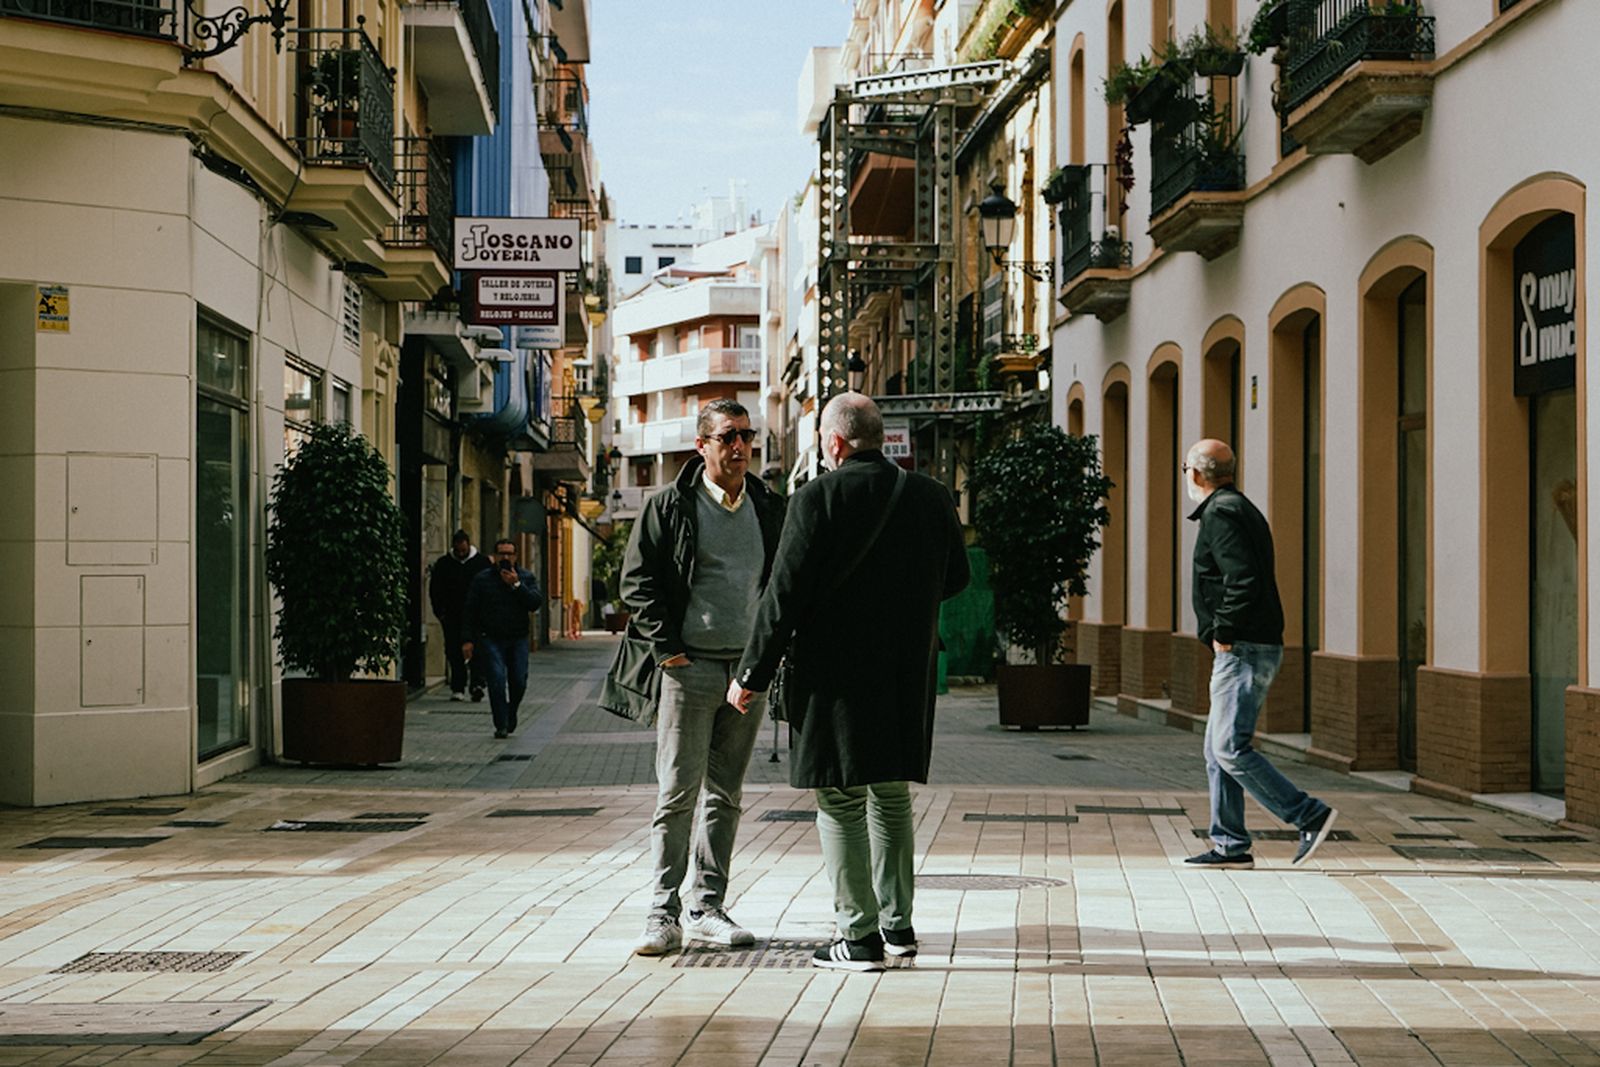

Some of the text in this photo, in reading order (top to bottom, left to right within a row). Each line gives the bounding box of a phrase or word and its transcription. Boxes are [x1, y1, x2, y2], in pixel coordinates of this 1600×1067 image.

[470, 224, 573, 249] TOSCANO
[462, 237, 541, 262] JOYERIA
[481, 280, 509, 288] TALLER
[511, 280, 520, 288] DE
[1539, 268, 1576, 314] muy
[493, 293, 541, 301] Y RELOJERIA
[480, 310, 553, 320] RELOJES REGALOS
[1539, 317, 1576, 362] muc
